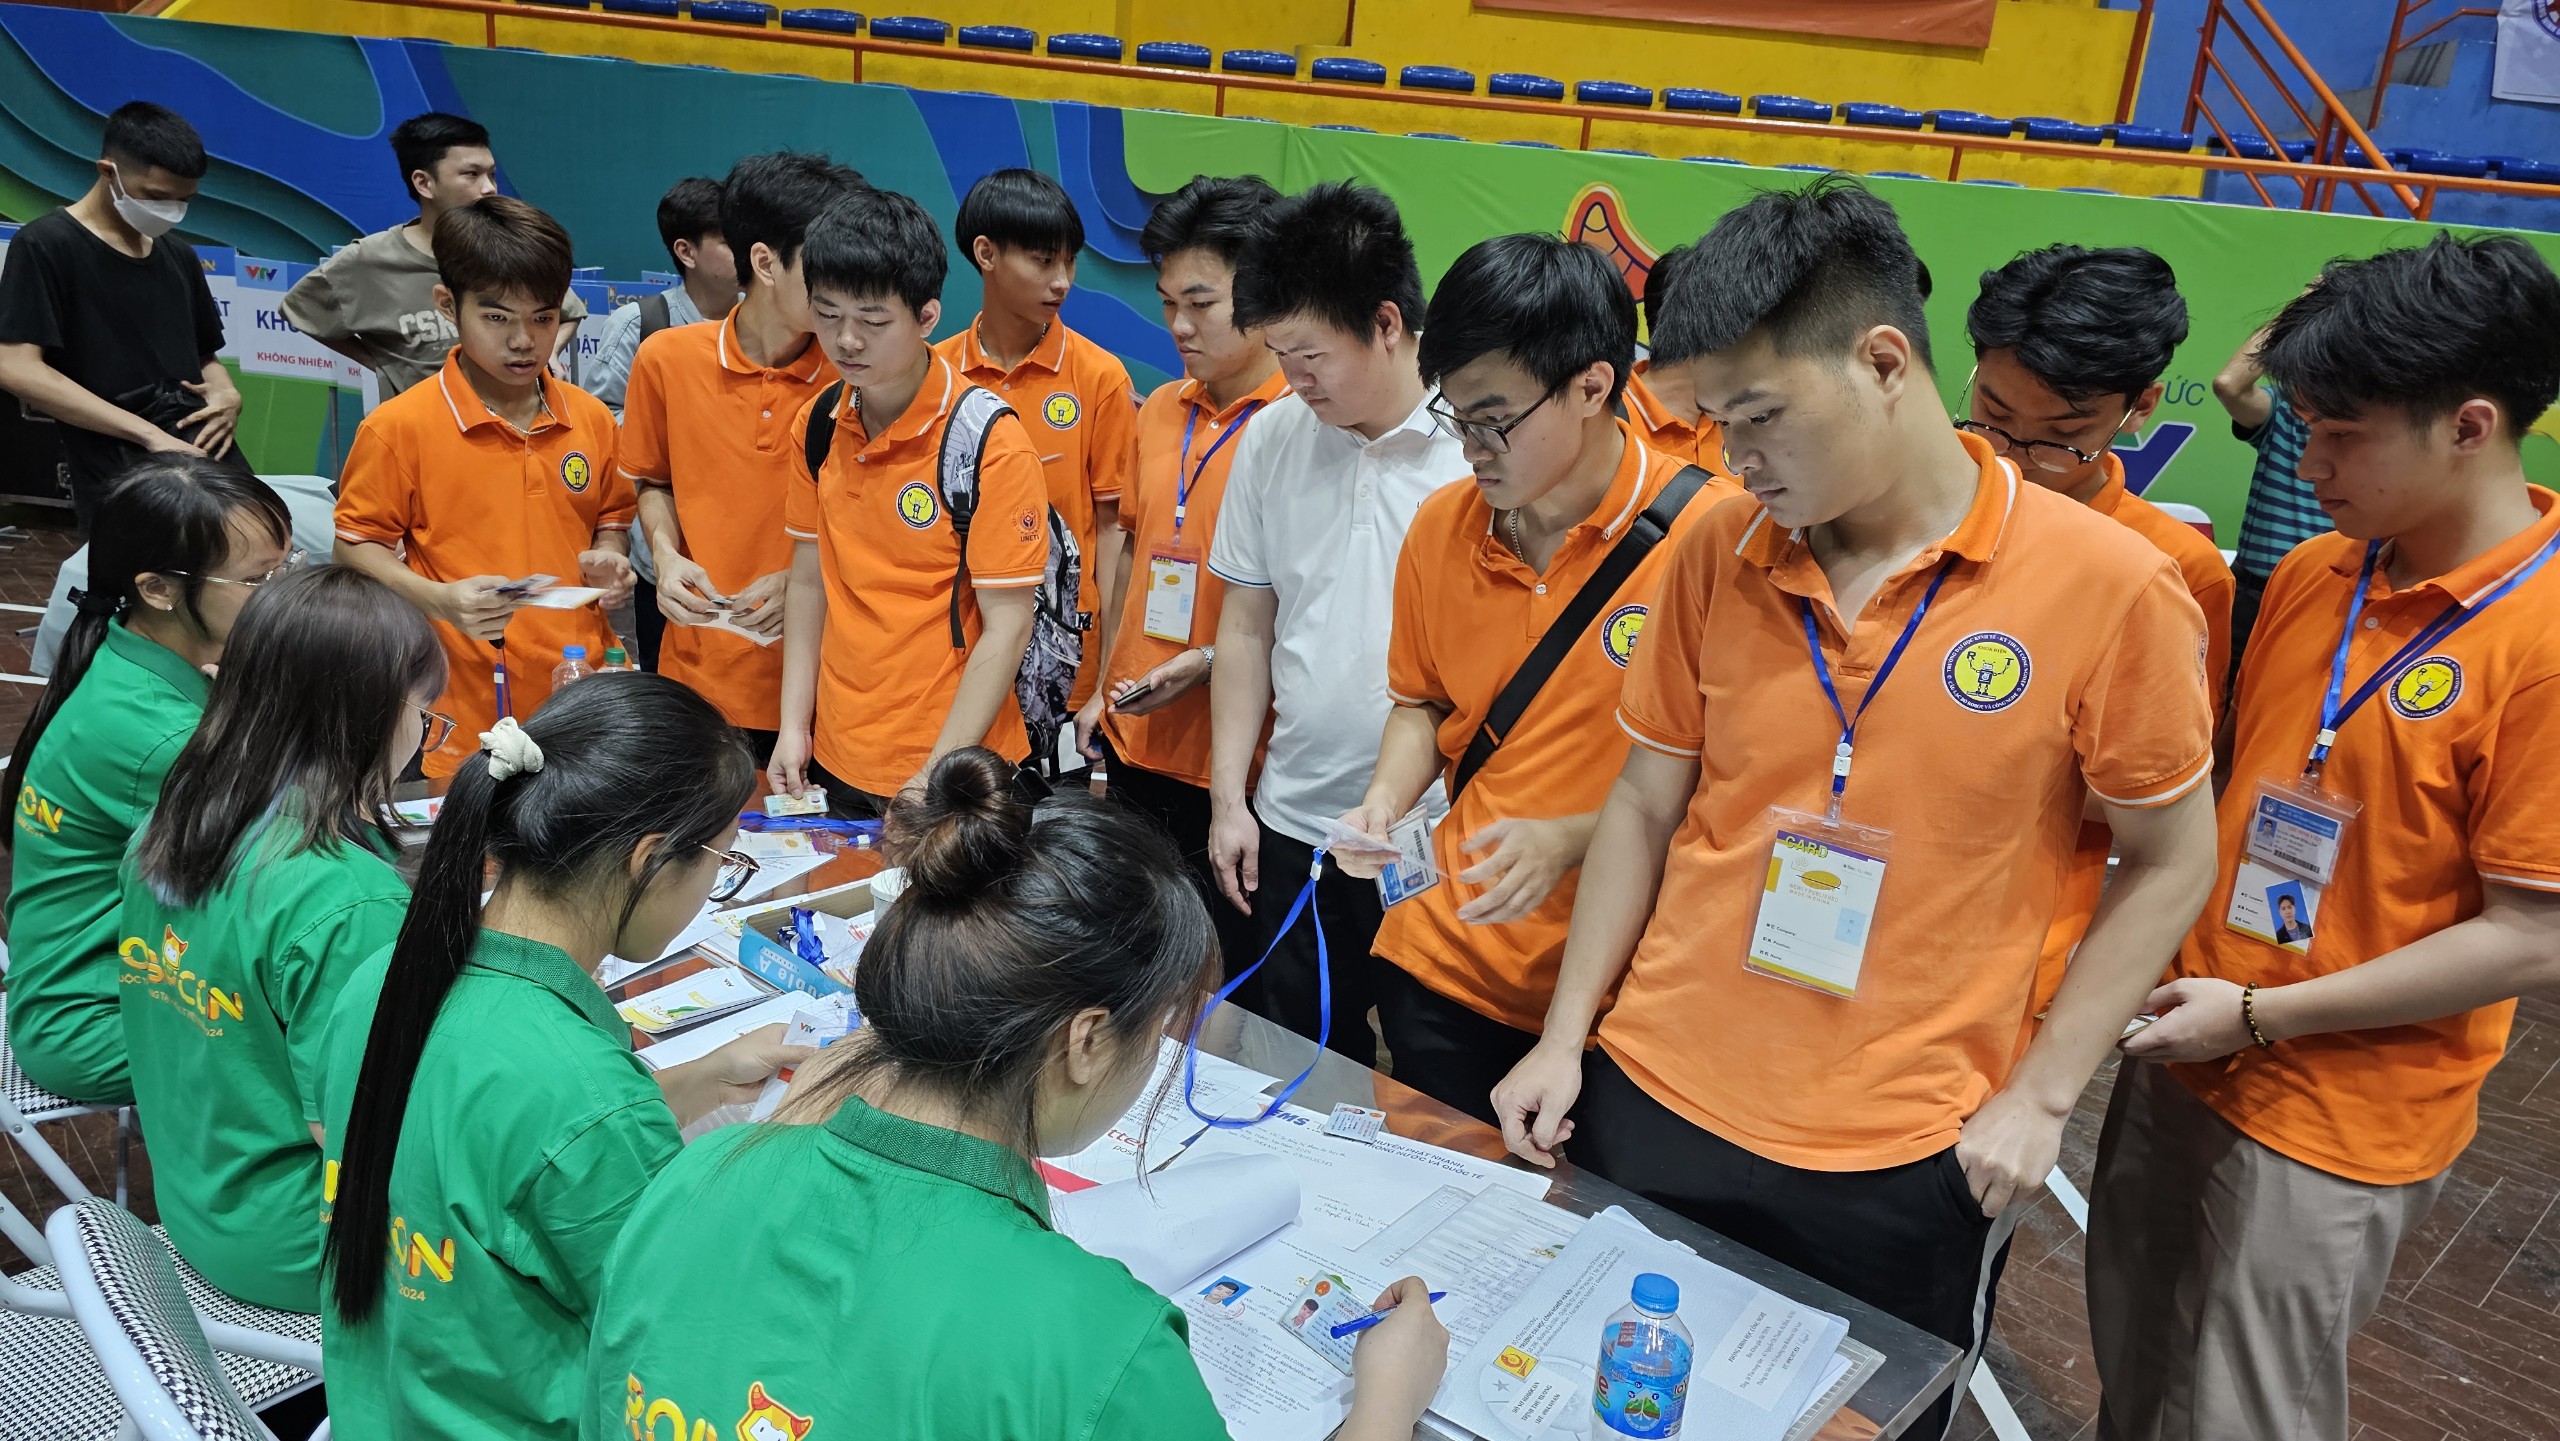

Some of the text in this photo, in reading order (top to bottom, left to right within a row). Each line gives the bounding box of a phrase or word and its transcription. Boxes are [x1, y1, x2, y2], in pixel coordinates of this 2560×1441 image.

[246, 265, 278, 281] VTV
[257, 351, 333, 370] KHÔNG NHIỆM
[1967, 651, 1976, 660] R
[2005, 658, 2014, 666] T
[1785, 836, 1829, 859] CARD
[1789, 889, 1806, 899] MADE
[800, 1022, 815, 1033] VTV
[1365, 1143, 1394, 1153] TRONG
[1428, 1159, 1440, 1167] VÀ
[1442, 1165, 1469, 1176] QUỐC
[1431, 1155, 1465, 1168] NHANH
